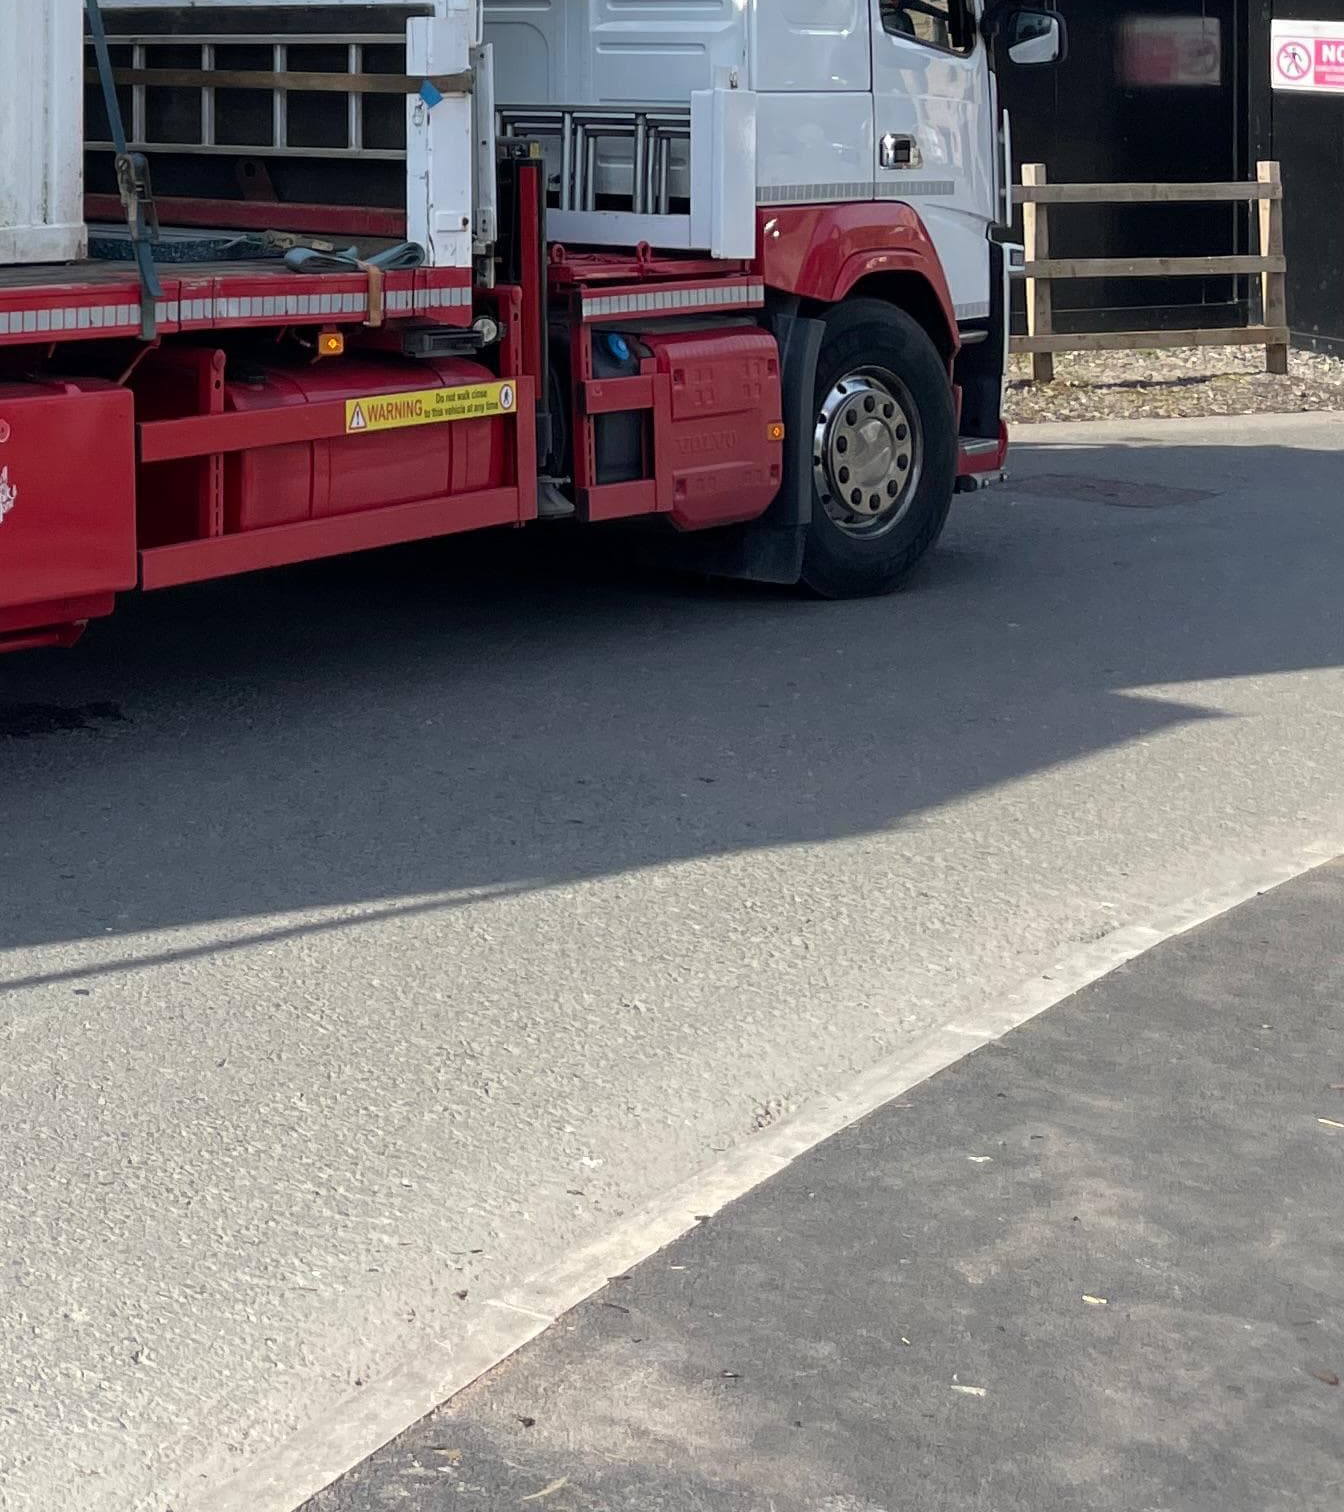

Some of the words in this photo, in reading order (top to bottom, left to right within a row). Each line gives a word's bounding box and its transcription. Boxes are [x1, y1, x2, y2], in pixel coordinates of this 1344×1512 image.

[435, 392, 444, 404] Do
[445, 391, 455, 402] not
[457, 390, 469, 401] walk
[471, 389, 487, 399] close
[367, 399, 423, 423] WARNING
[424, 409, 431, 418] to
[432, 407, 444, 417] this
[445, 404, 465, 415] vehicle
[466, 404, 472, 414] at
[474, 403, 485, 414] any
[486, 400, 499, 410] time
